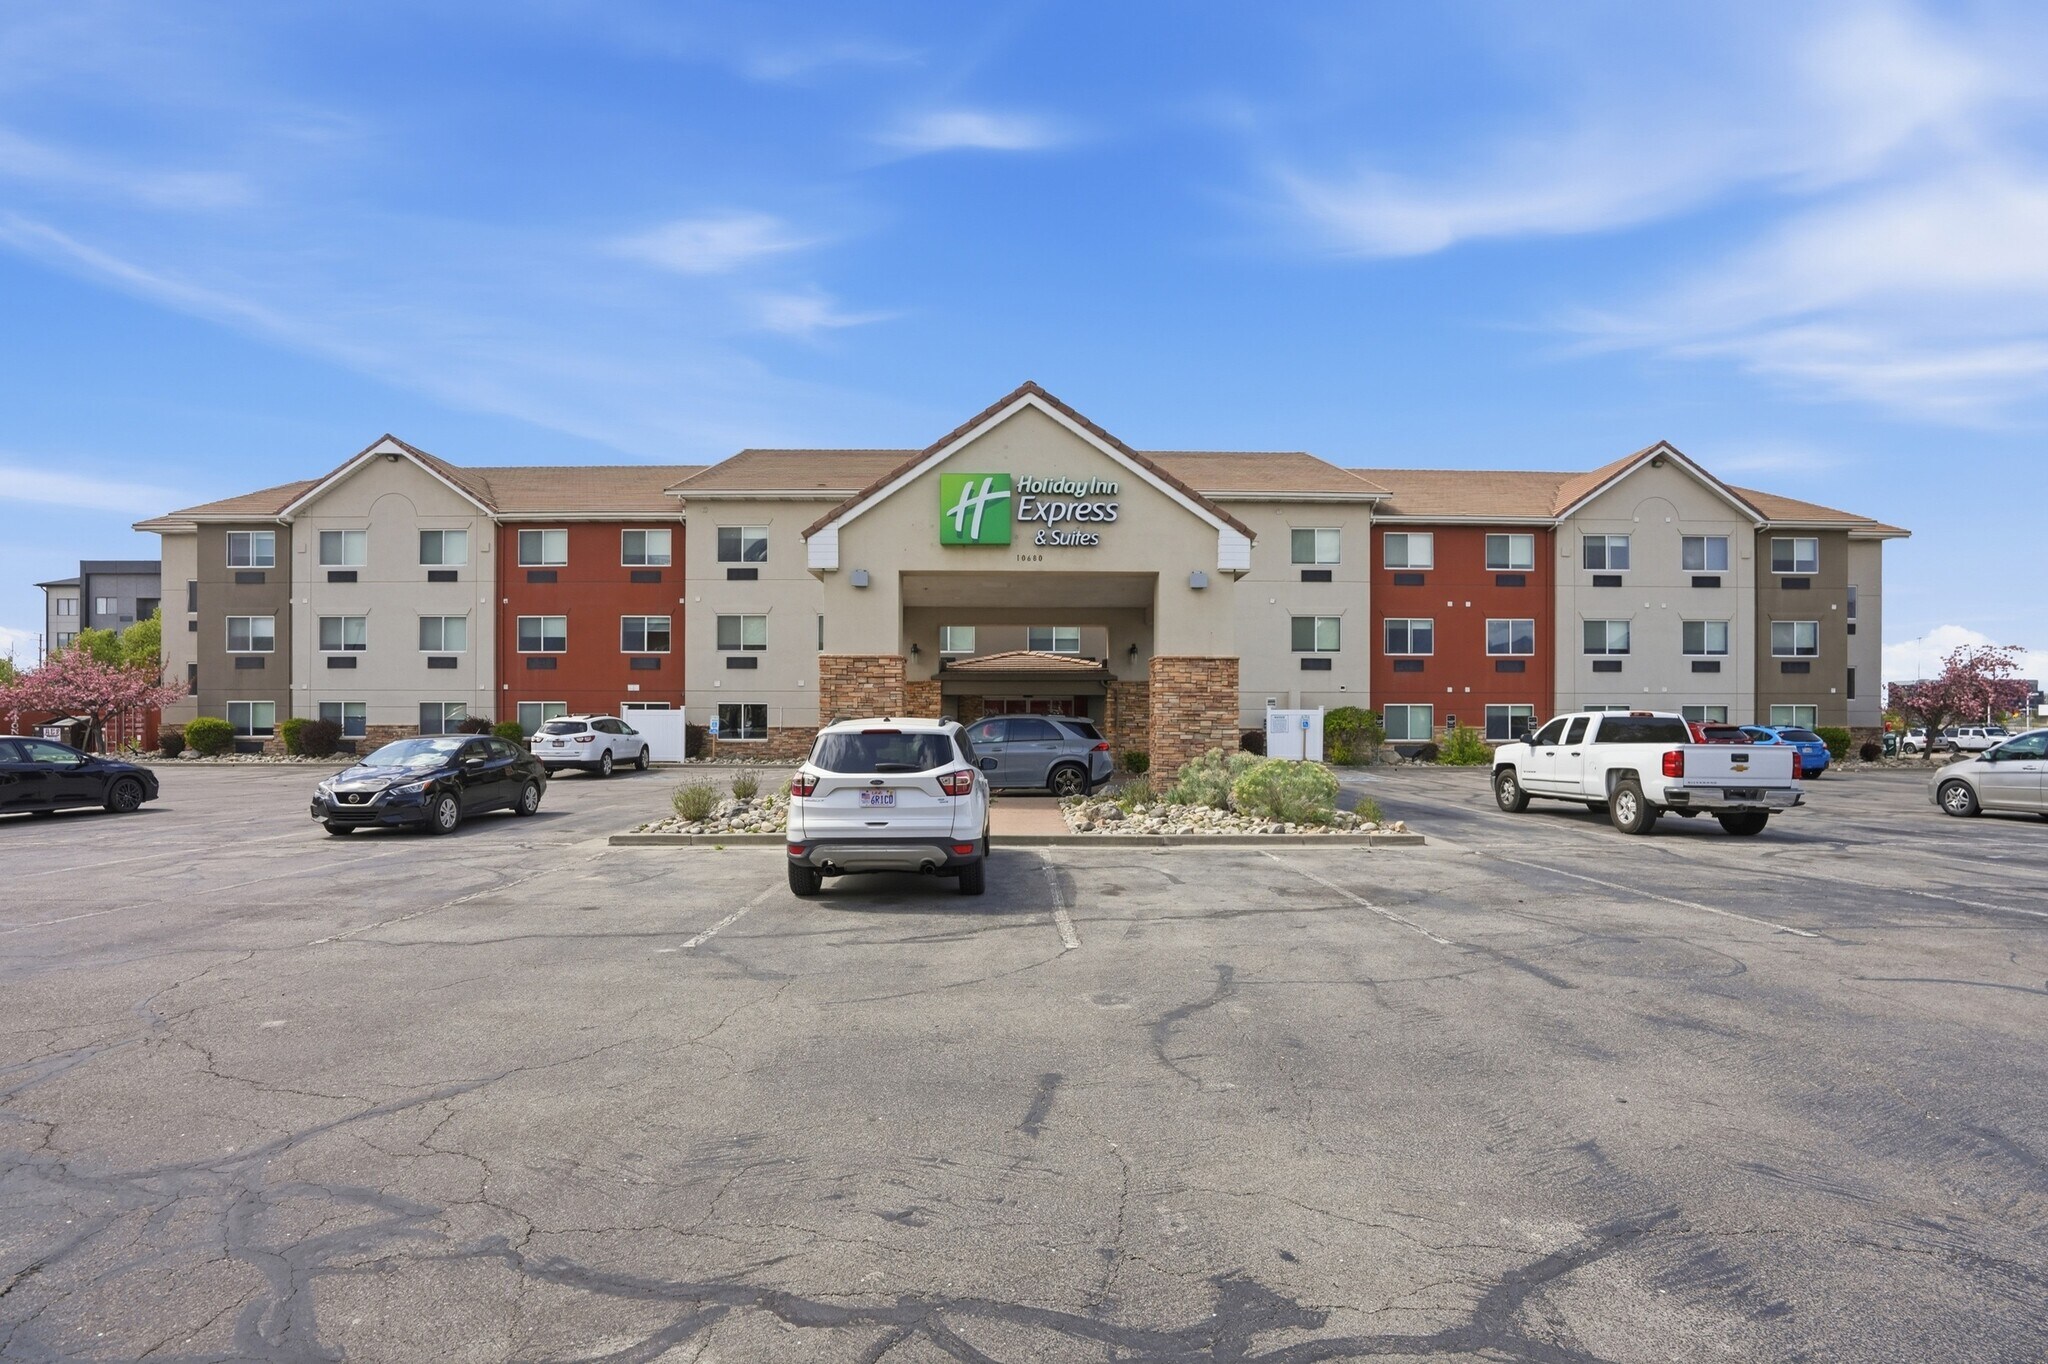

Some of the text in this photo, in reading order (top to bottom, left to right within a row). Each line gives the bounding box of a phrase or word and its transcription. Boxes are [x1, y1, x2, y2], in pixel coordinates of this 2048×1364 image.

[1017, 475, 1119, 498] Holiday Inn
[1017, 495, 1119, 528] Express
[1034, 529, 1099, 546] & Suites
[1016, 554, 1043, 562] 10680
